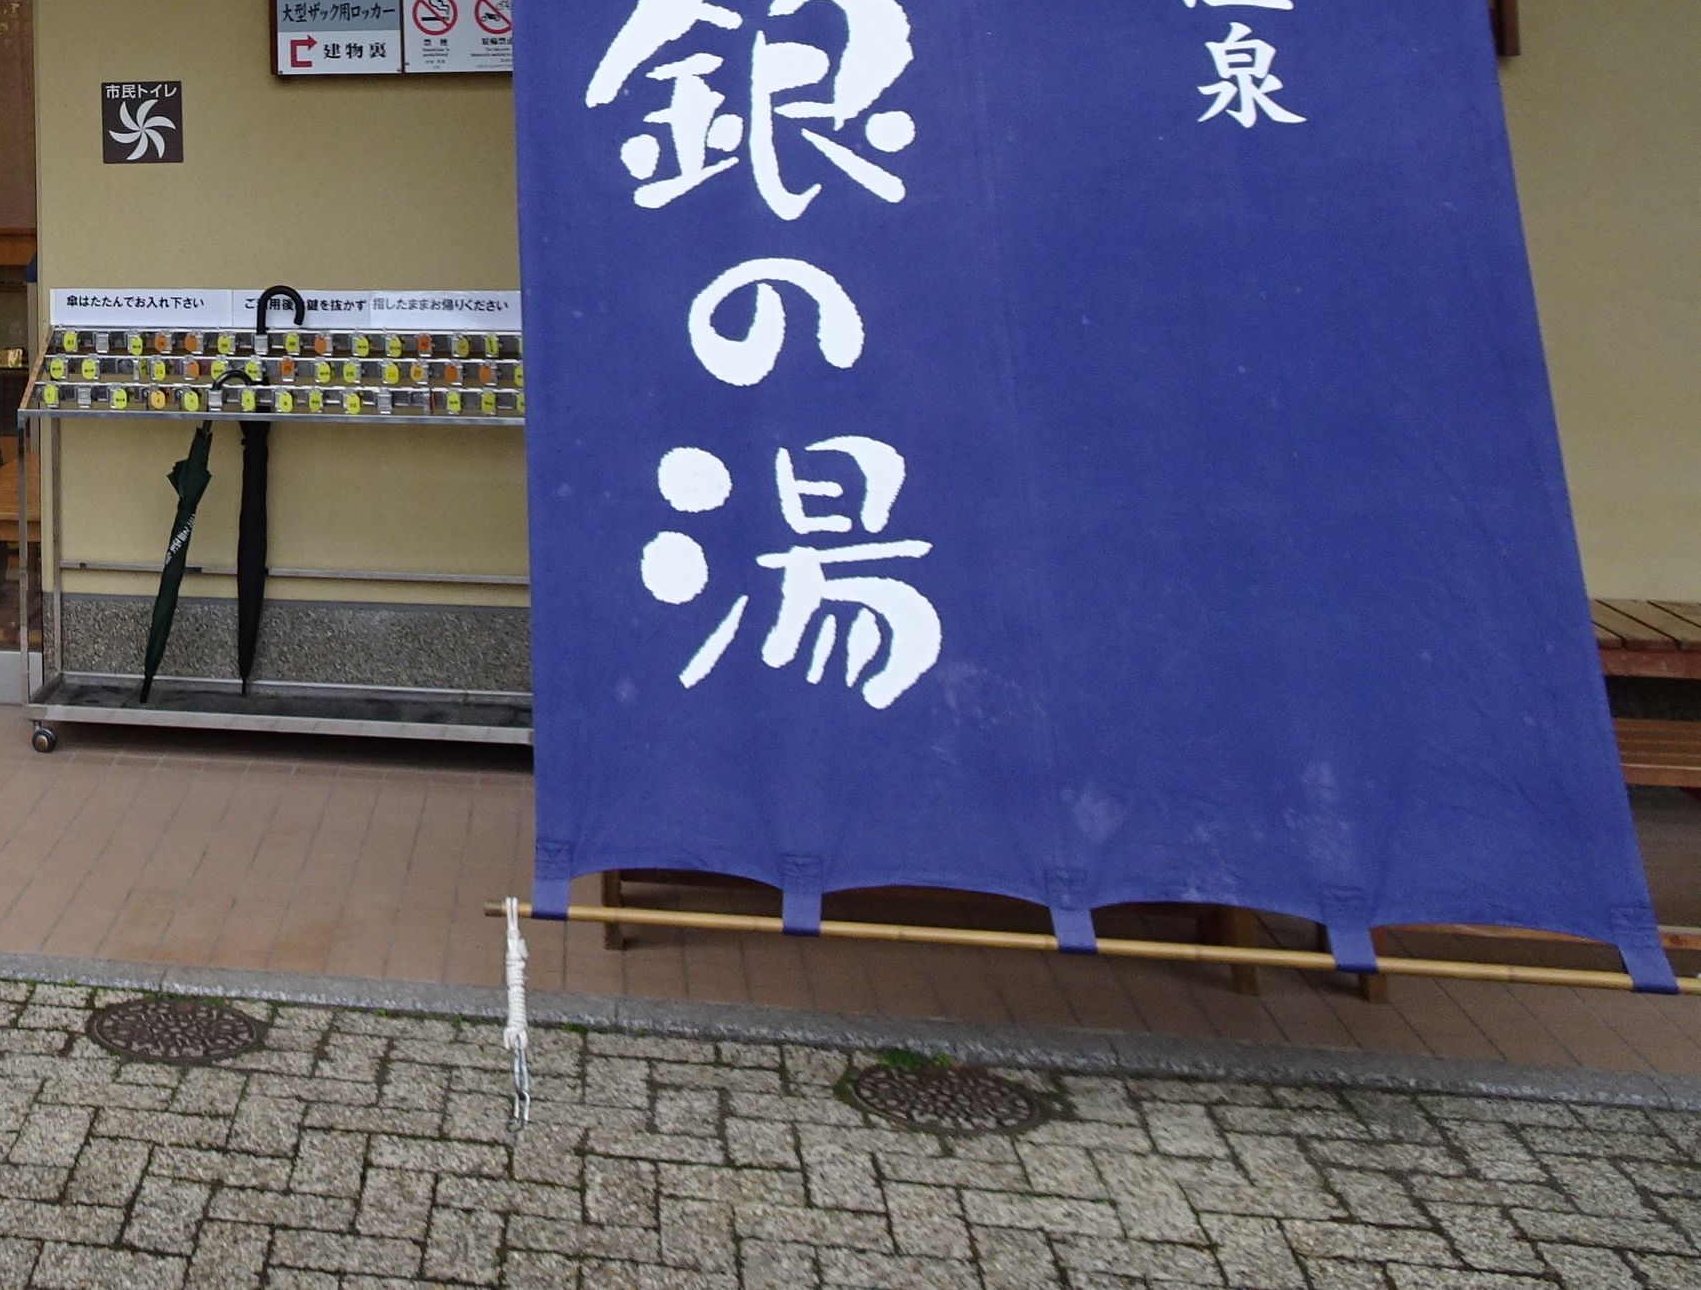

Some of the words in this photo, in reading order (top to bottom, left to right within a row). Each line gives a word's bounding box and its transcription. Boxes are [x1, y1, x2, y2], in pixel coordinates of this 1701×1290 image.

[281, 1, 396, 23] 大型ザック用ロッカー
[322, 41, 387, 60] 建物裏
[105, 83, 177, 99] 市民トイレ
[66, 294, 205, 309] 傘はたたんでお入れ下さい
[245, 297, 367, 311] ご用後鍵を抜かず
